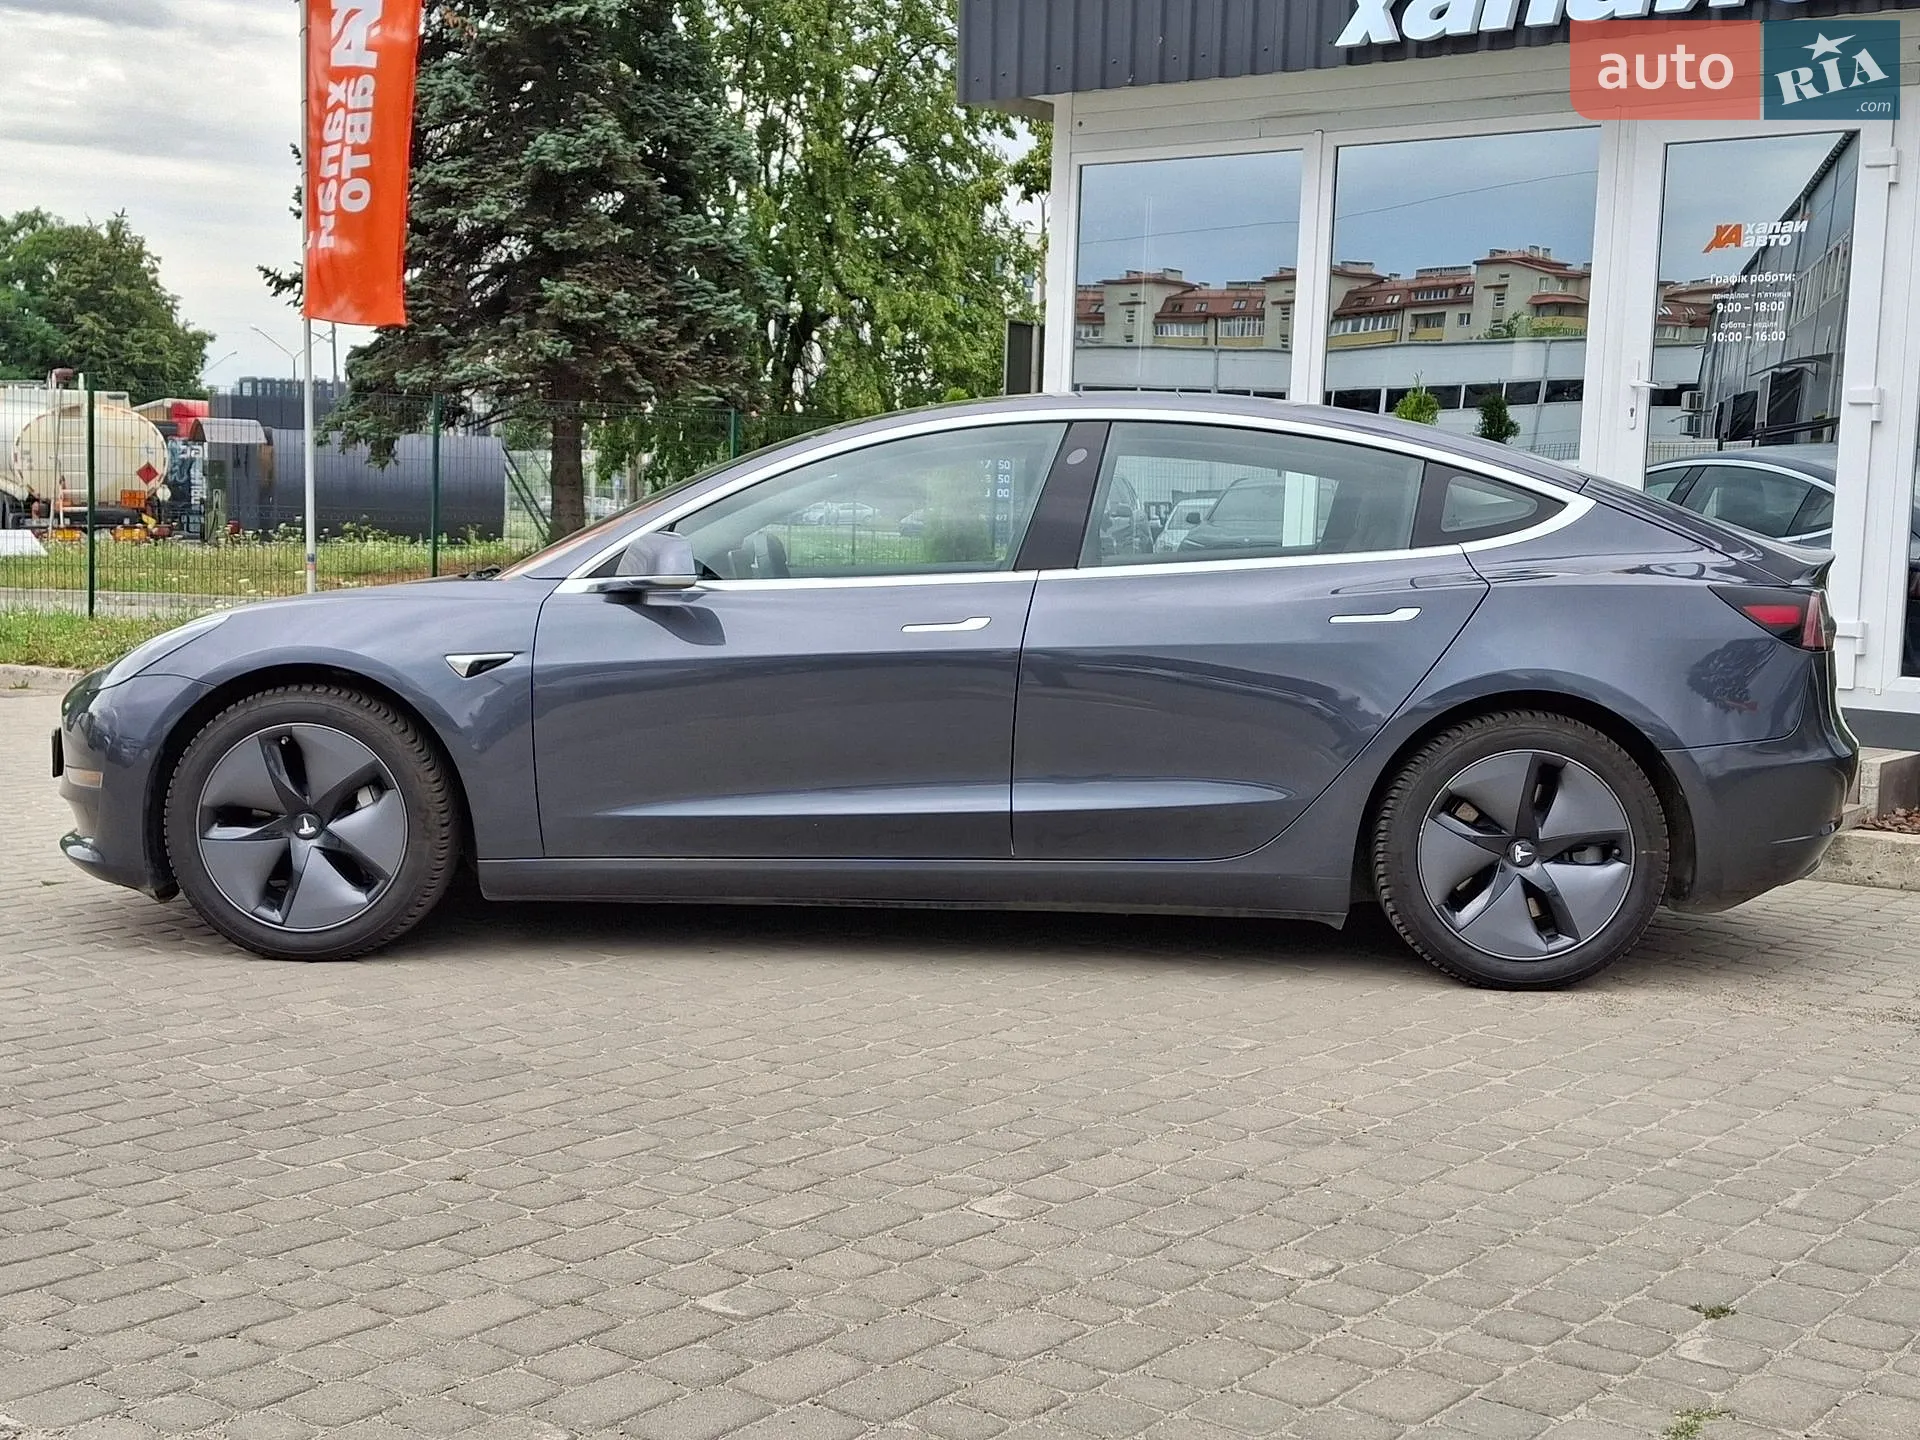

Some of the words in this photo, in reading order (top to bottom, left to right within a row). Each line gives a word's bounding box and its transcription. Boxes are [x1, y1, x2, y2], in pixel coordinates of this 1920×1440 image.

[1743, 234, 1792, 248] авто
[1710, 273, 1748, 286] Графік
[1750, 272, 1796, 285] роботи:
[1716, 302, 1741, 312] 9:00
[1754, 301, 1785, 312] 18:00
[1720, 321, 1746, 330] субота
[1712, 332, 1742, 342] 10:00
[1755, 331, 1786, 342] 16:00
[998, 474, 1010, 483] 50
[997, 489, 1009, 497] 00
